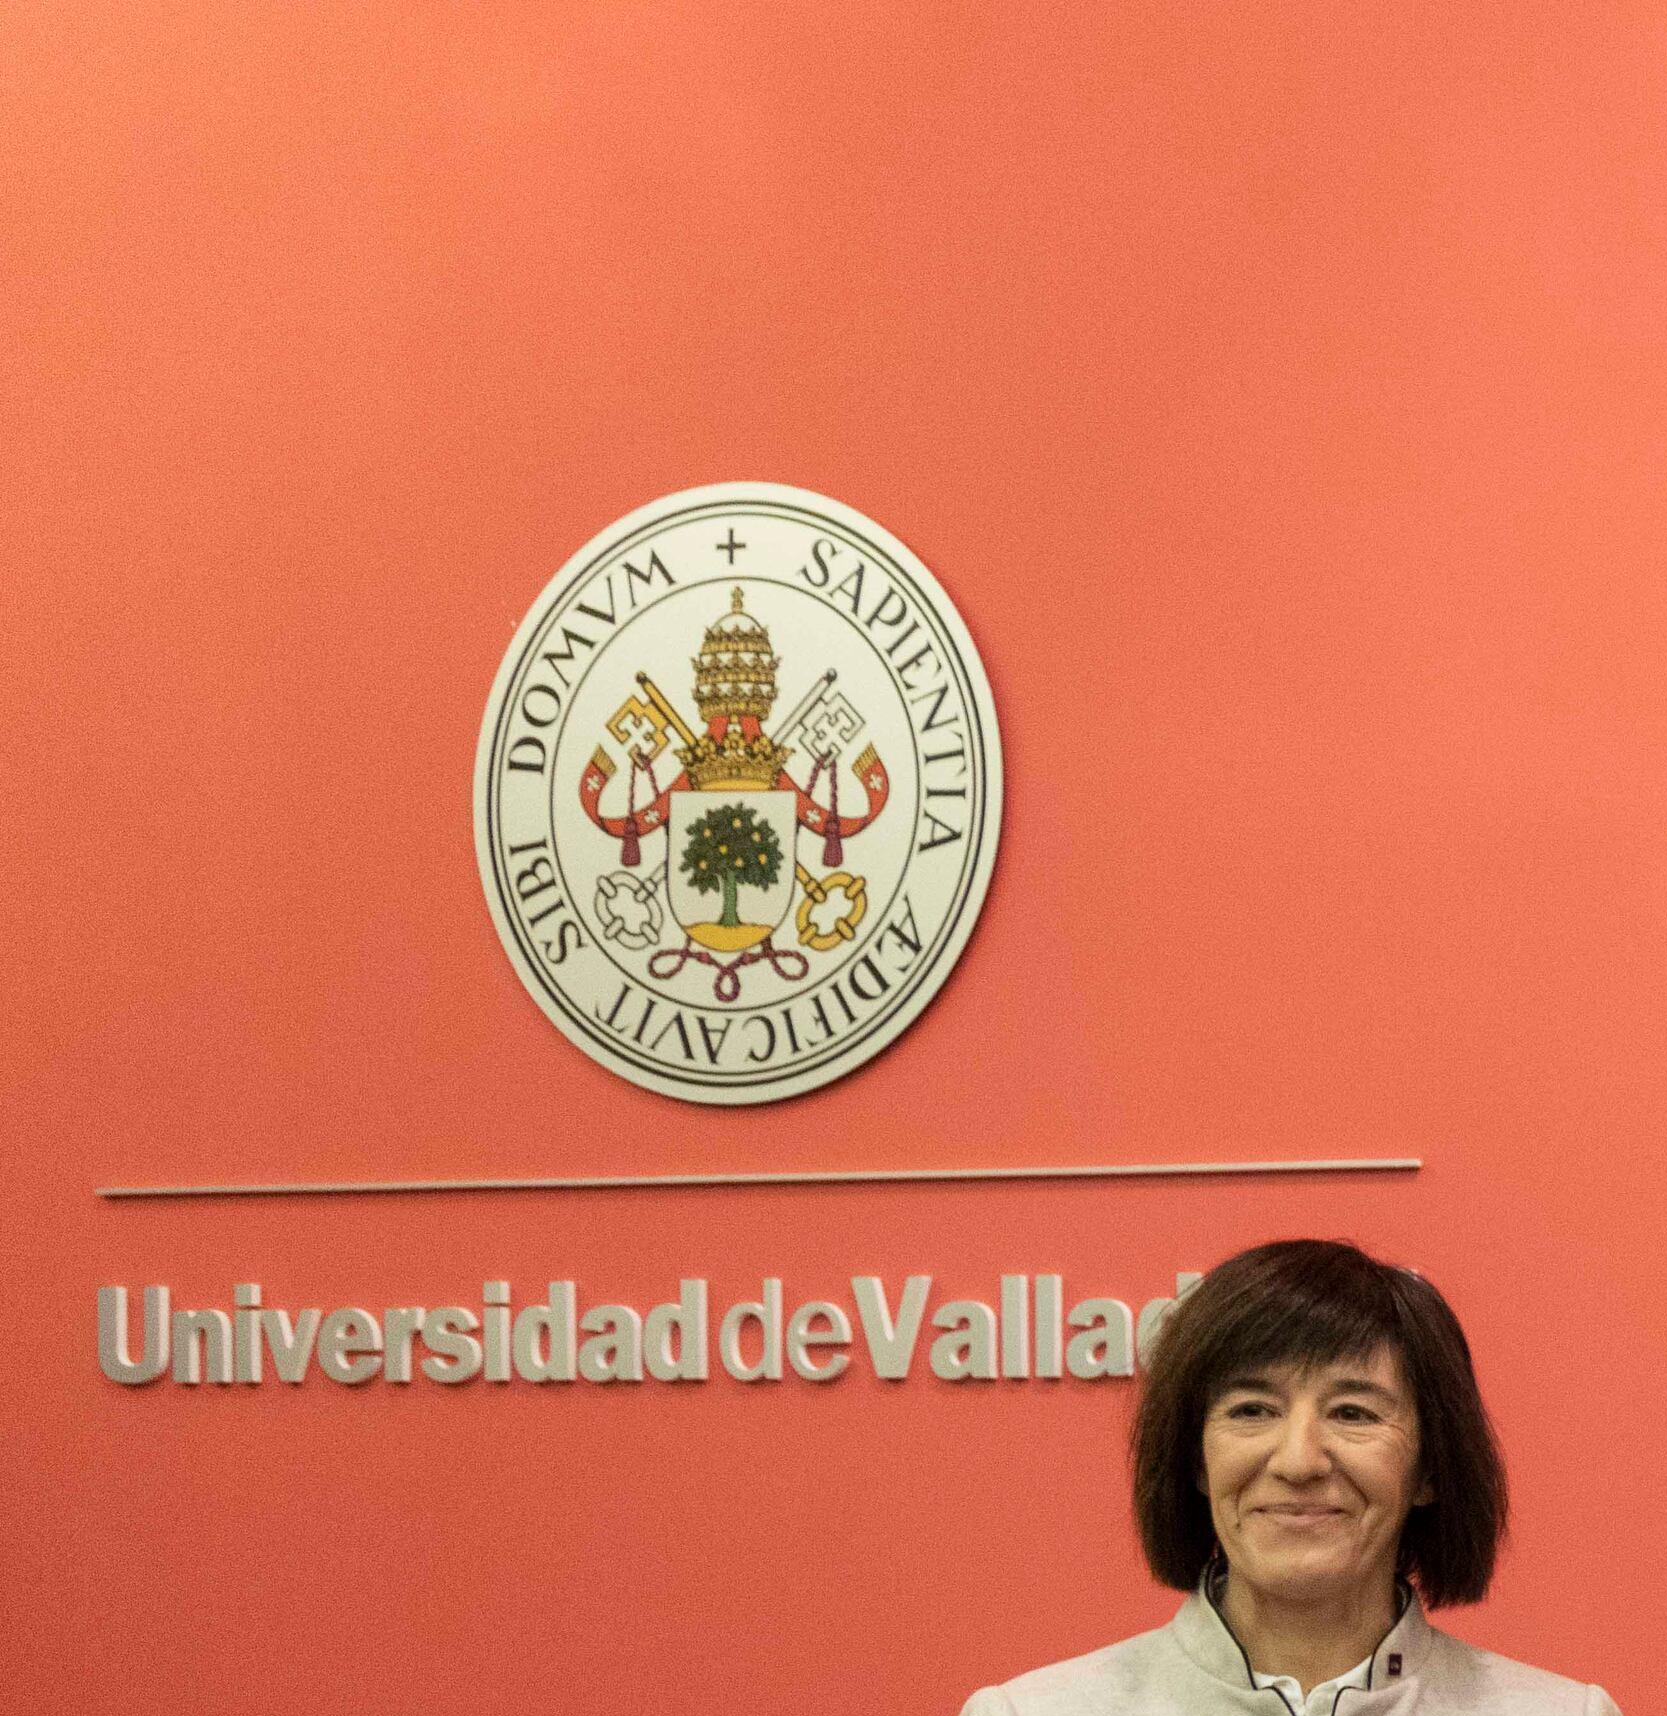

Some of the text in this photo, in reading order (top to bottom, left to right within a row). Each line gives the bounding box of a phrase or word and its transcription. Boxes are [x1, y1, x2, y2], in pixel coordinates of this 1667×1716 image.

[508, 548, 678, 775] DOMVM
[797, 540, 968, 854] SAPIENTIA
[509, 837, 586, 966] SIBI
[98, 1278, 708, 1385] Universidad
[720, 1278, 852, 1381] de
